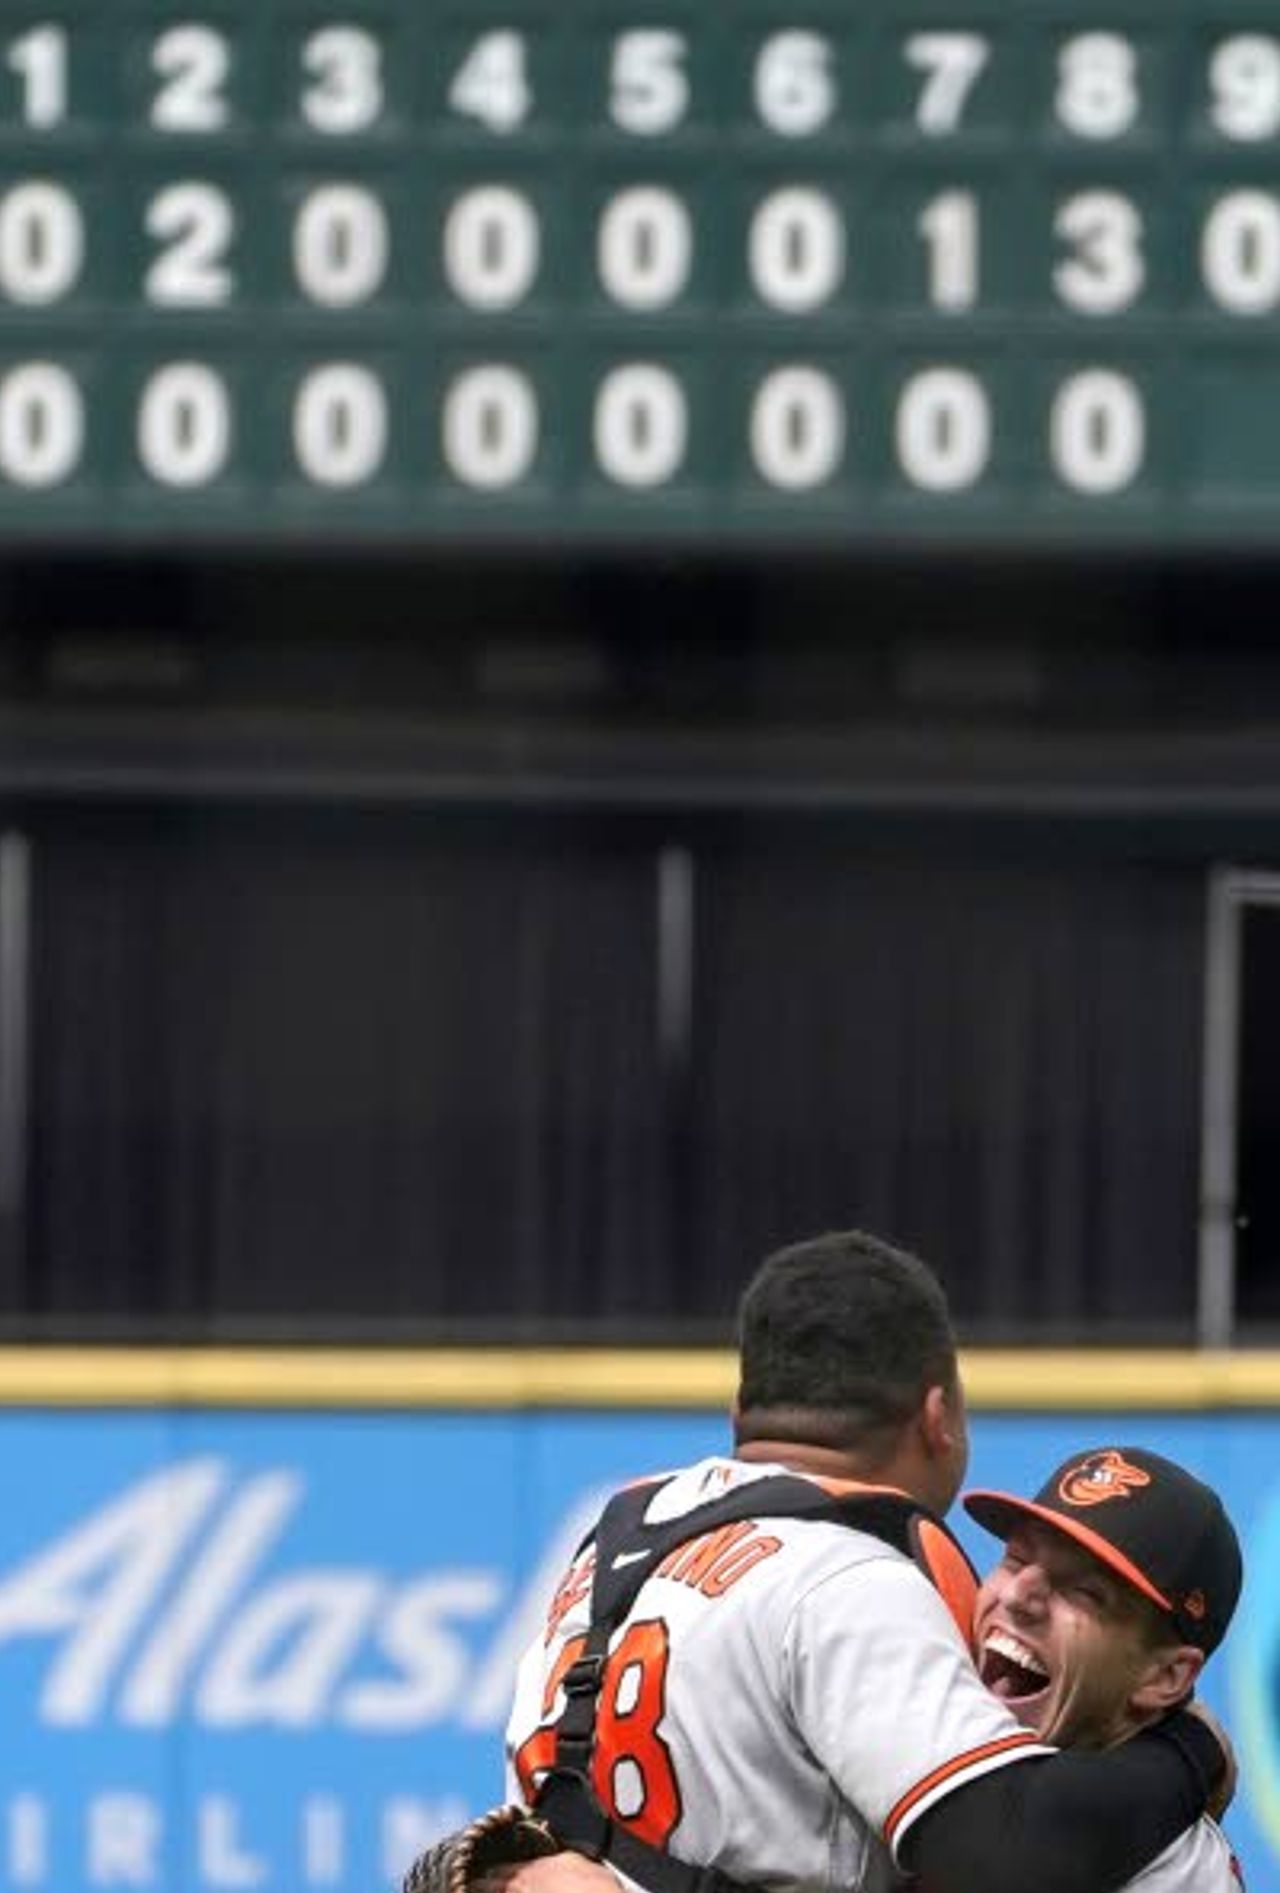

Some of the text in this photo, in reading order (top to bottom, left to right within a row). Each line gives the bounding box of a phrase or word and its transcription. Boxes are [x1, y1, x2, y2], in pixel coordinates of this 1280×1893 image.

[10, 27, 65, 129] 1
[151, 26, 227, 131] 2
[303, 29, 380, 134] 3
[451, 32, 528, 132] 4
[612, 31, 687, 133] 5
[756, 31, 832, 135] 6
[908, 33, 986, 132] 7
[1056, 34, 1137, 138] 8
[147, 184, 232, 306] 2
[294, 186, 386, 306] 0
[445, 186, 538, 309] 0
[599, 188, 690, 309] 0
[750, 188, 840, 312] 0
[922, 192, 976, 311] 1
[1056, 193, 1143, 314] 3
[139, 364, 229, 487] 0
[294, 364, 386, 486] 0
[444, 366, 536, 488] 0
[595, 364, 685, 486] 0
[751, 367, 841, 489] 0
[897, 369, 989, 491] 0
[1053, 370, 1143, 493] 0
